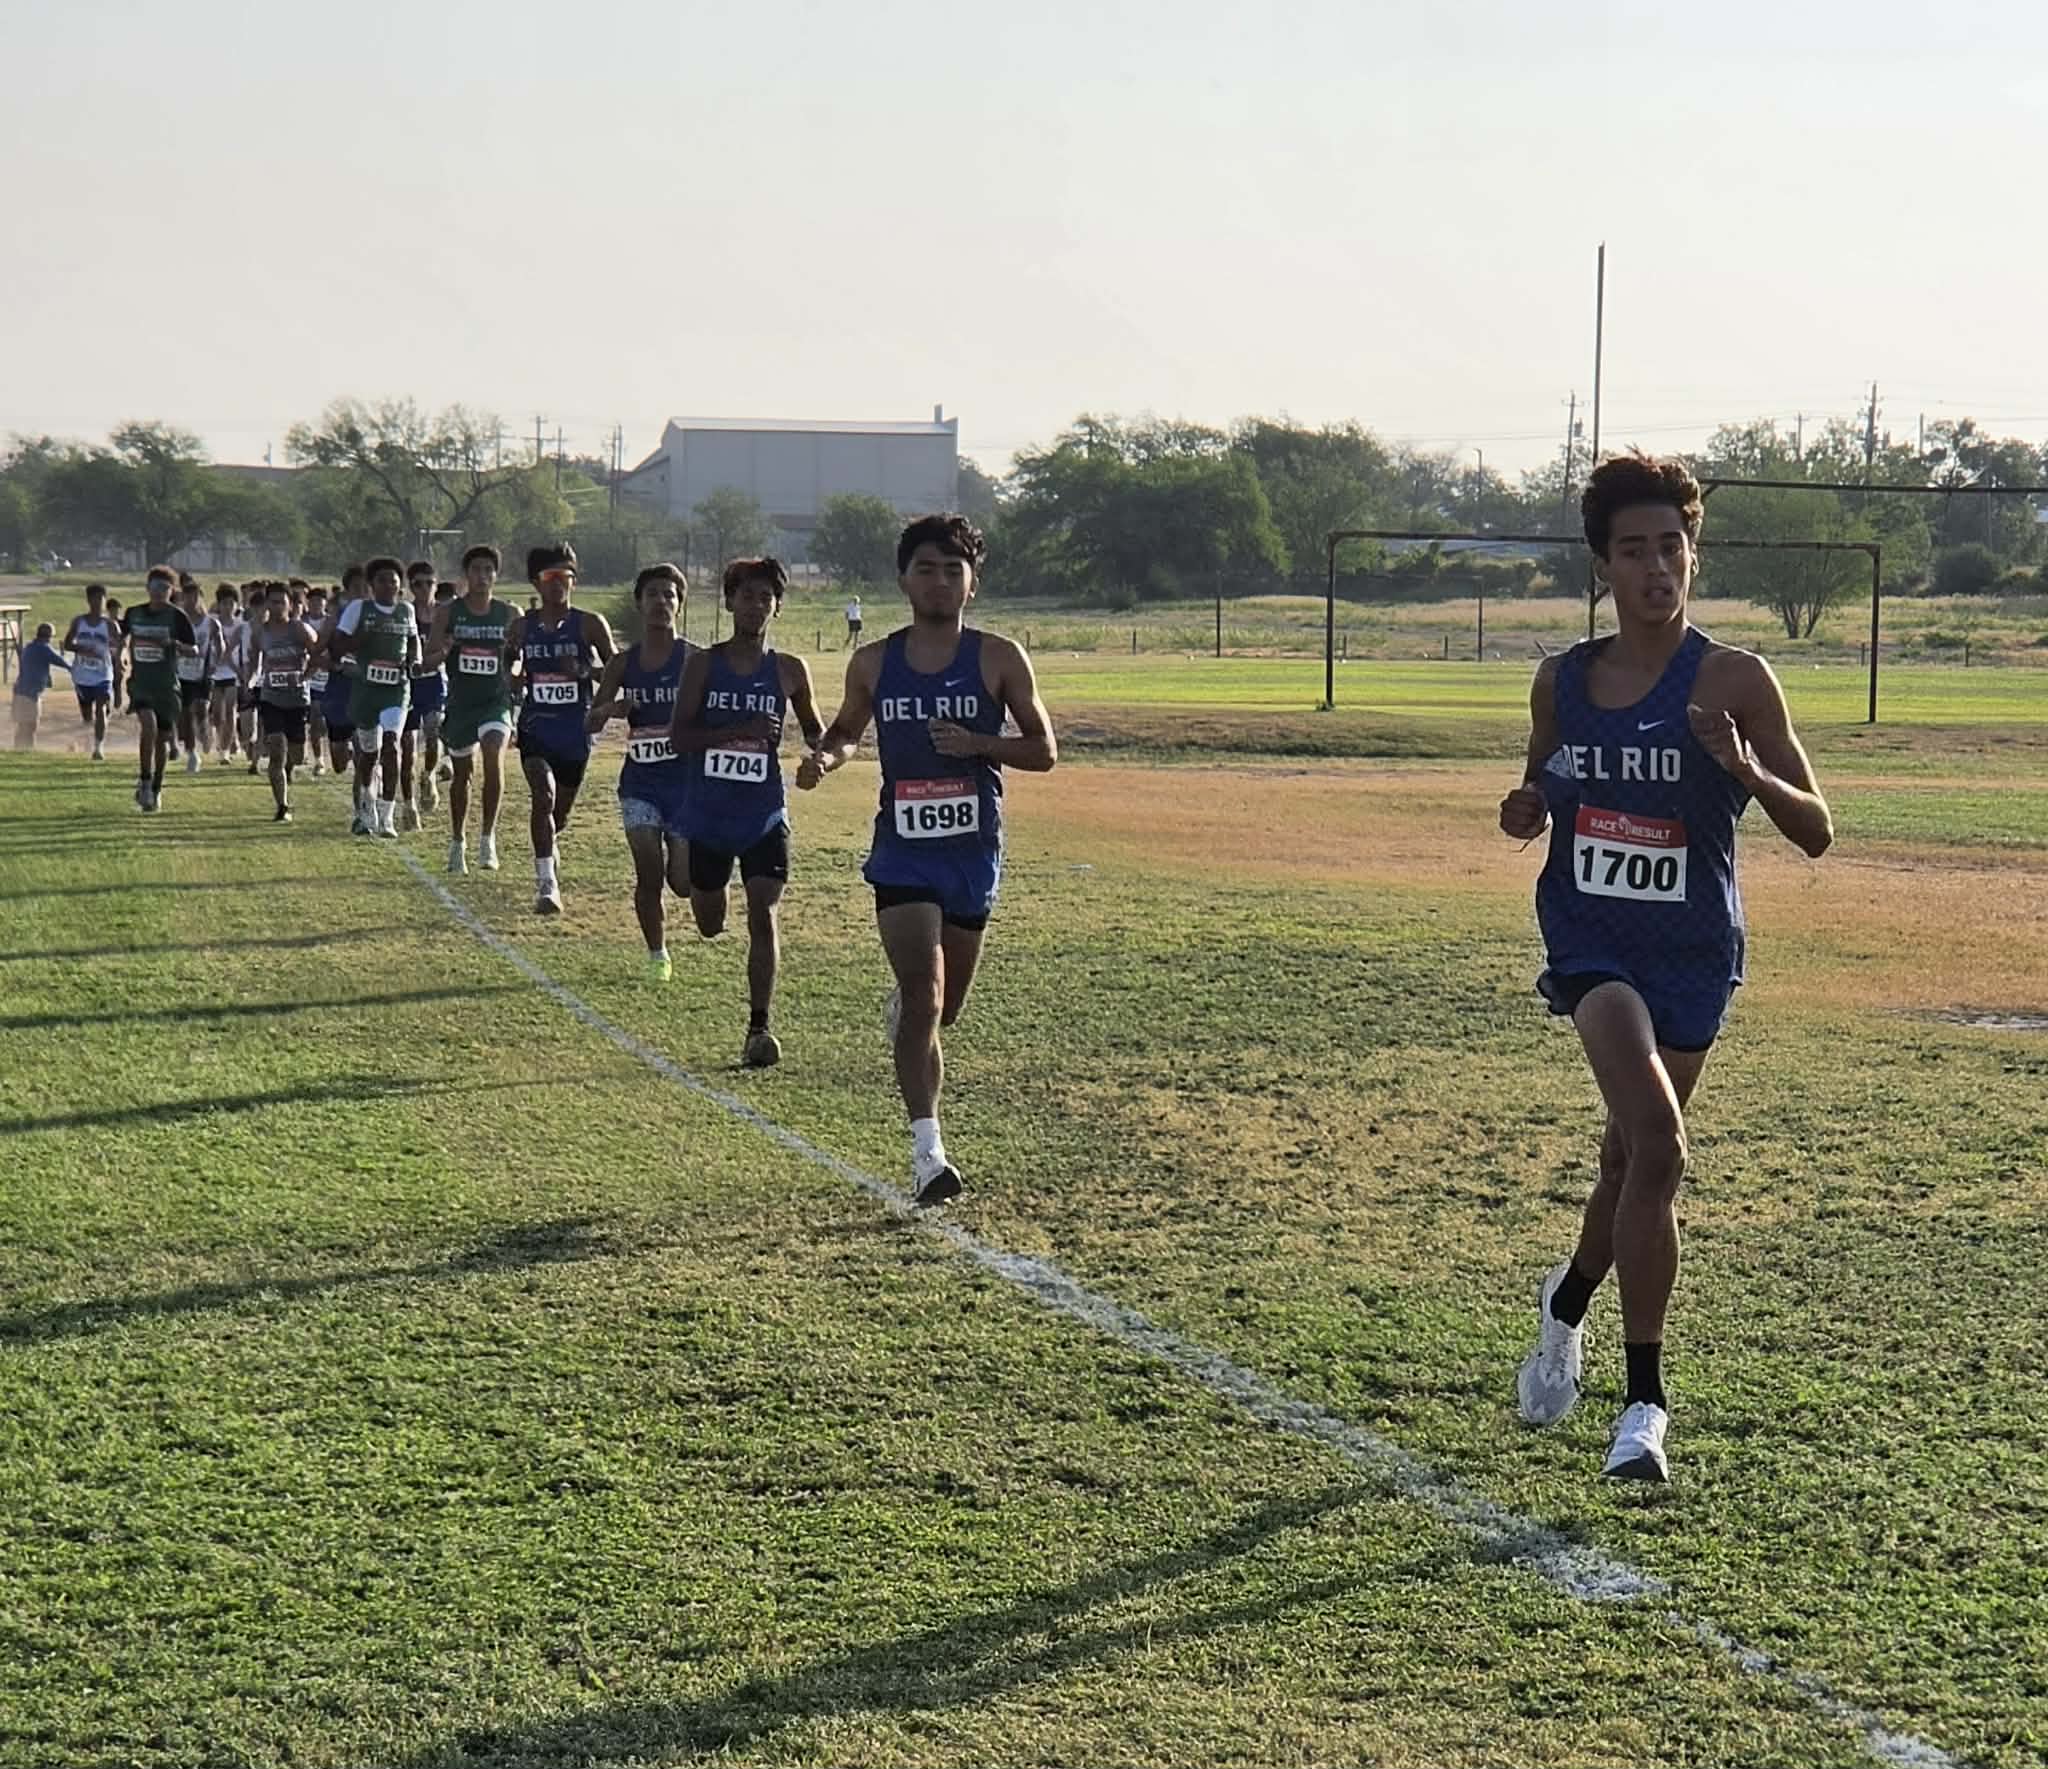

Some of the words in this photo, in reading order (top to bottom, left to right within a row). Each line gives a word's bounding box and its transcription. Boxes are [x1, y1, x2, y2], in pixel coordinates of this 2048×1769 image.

[526, 644, 551, 658] DEL
[463, 658, 495, 672] 1319
[536, 686, 574, 700] 1705
[707, 691, 741, 711] DEL
[746, 693, 777, 713] RIO
[882, 697, 928, 722] DEL
[936, 696, 978, 719] RIO
[709, 753, 763, 777] 1704
[1620, 747, 1681, 782] RIO
[902, 802, 973, 831] 1698
[1590, 817, 1617, 833] RACE
[1631, 825, 1671, 840] RESULT
[1580, 845, 1678, 892] 1700
